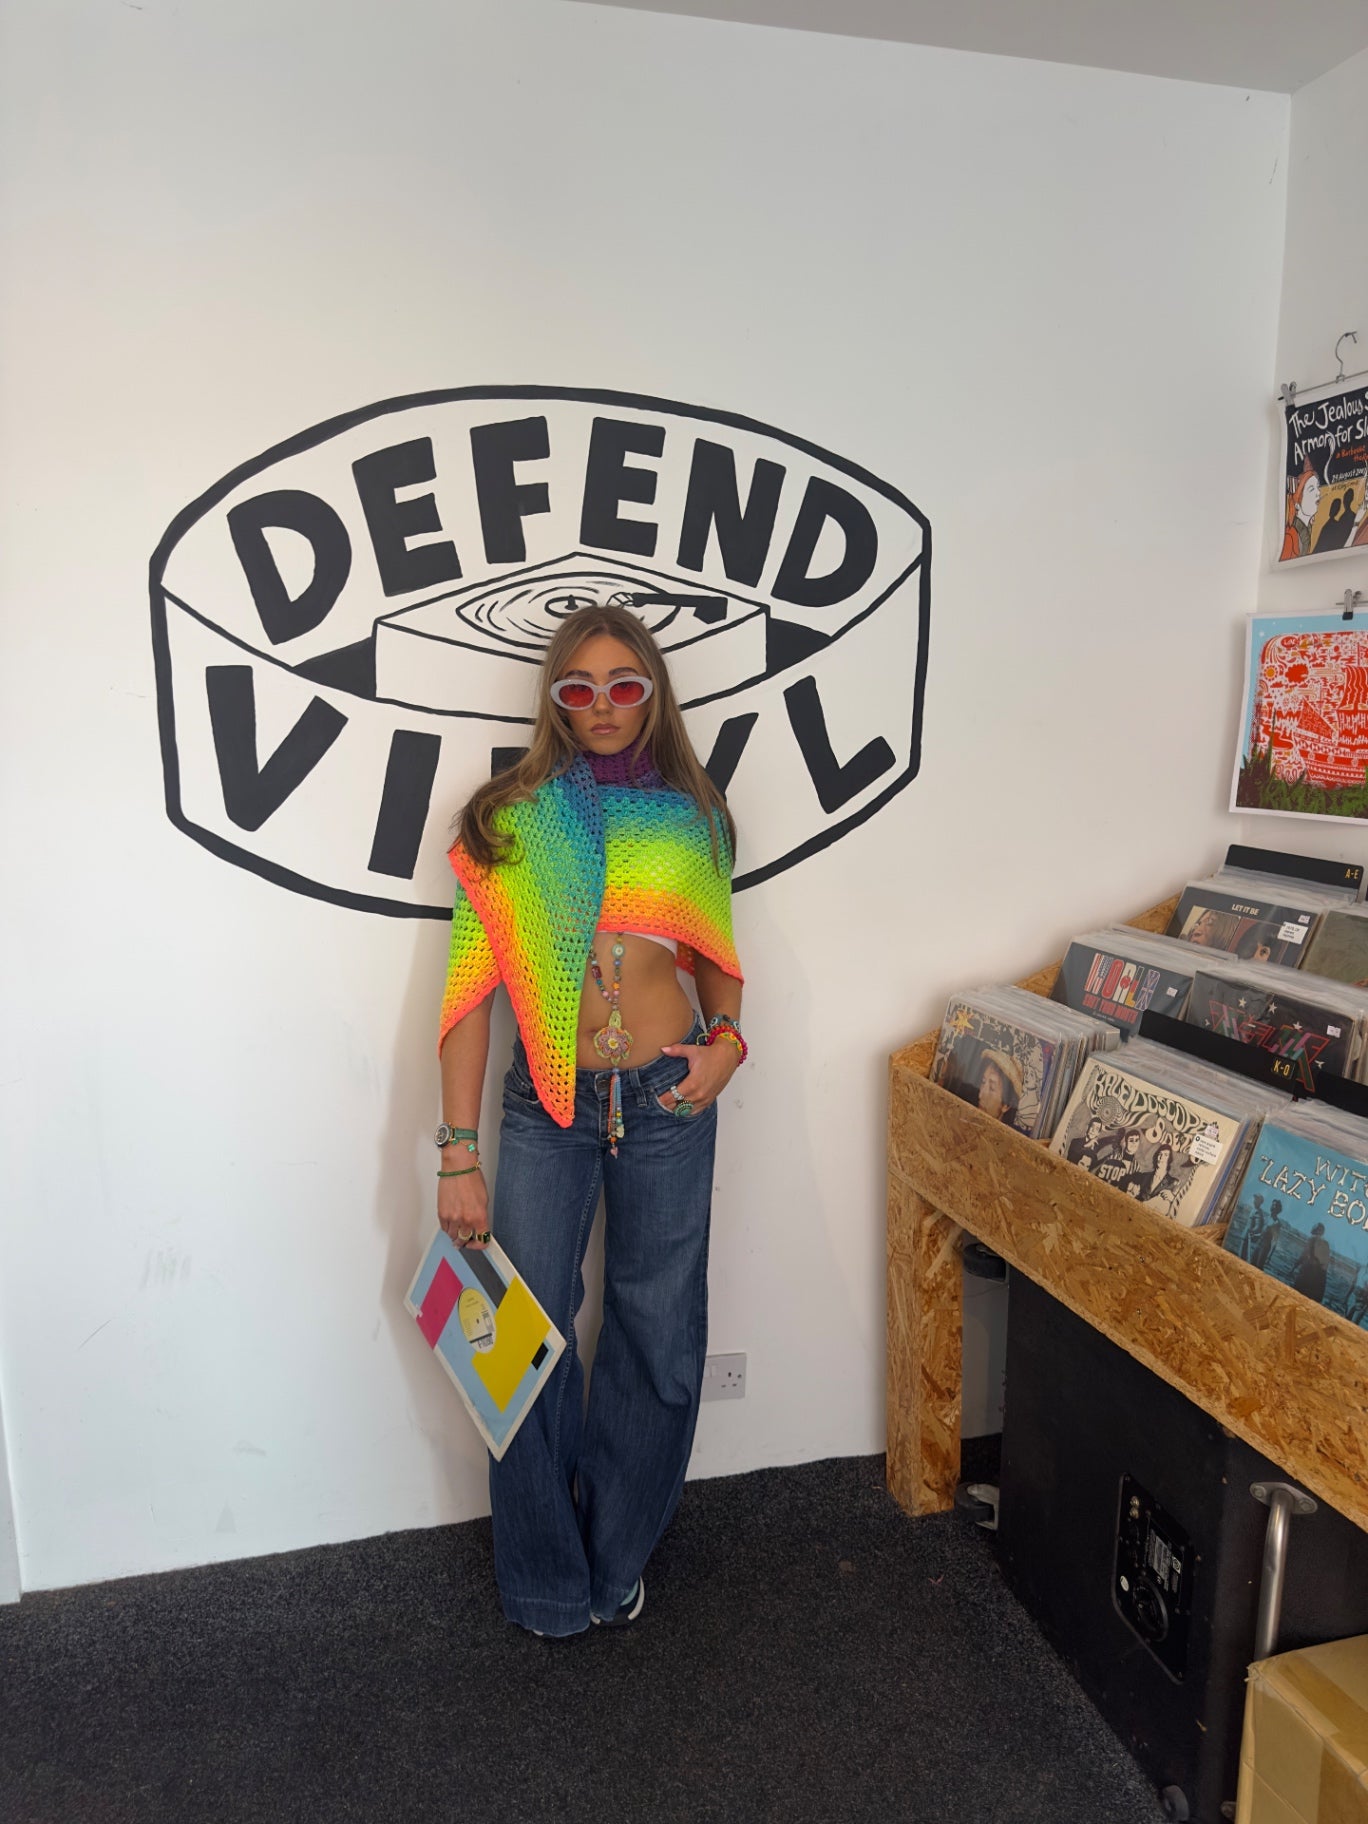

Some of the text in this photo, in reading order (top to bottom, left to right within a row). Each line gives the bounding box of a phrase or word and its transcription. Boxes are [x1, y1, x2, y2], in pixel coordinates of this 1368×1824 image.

[1288, 410, 1315, 439] The
[1314, 396, 1364, 430] Jealous
[1334, 425, 1354, 447] for
[1354, 415, 1368, 440] Sl
[226, 416, 879, 645] DEFEND
[205, 664, 897, 881] VIL
[1344, 868, 1360, 880] A-E
[1231, 903, 1260, 916] LET IT BE
[1098, 1164, 1127, 1182] STOP
[1260, 1155, 1326, 1206] LAZY
[1327, 1190, 1368, 1231] BO
